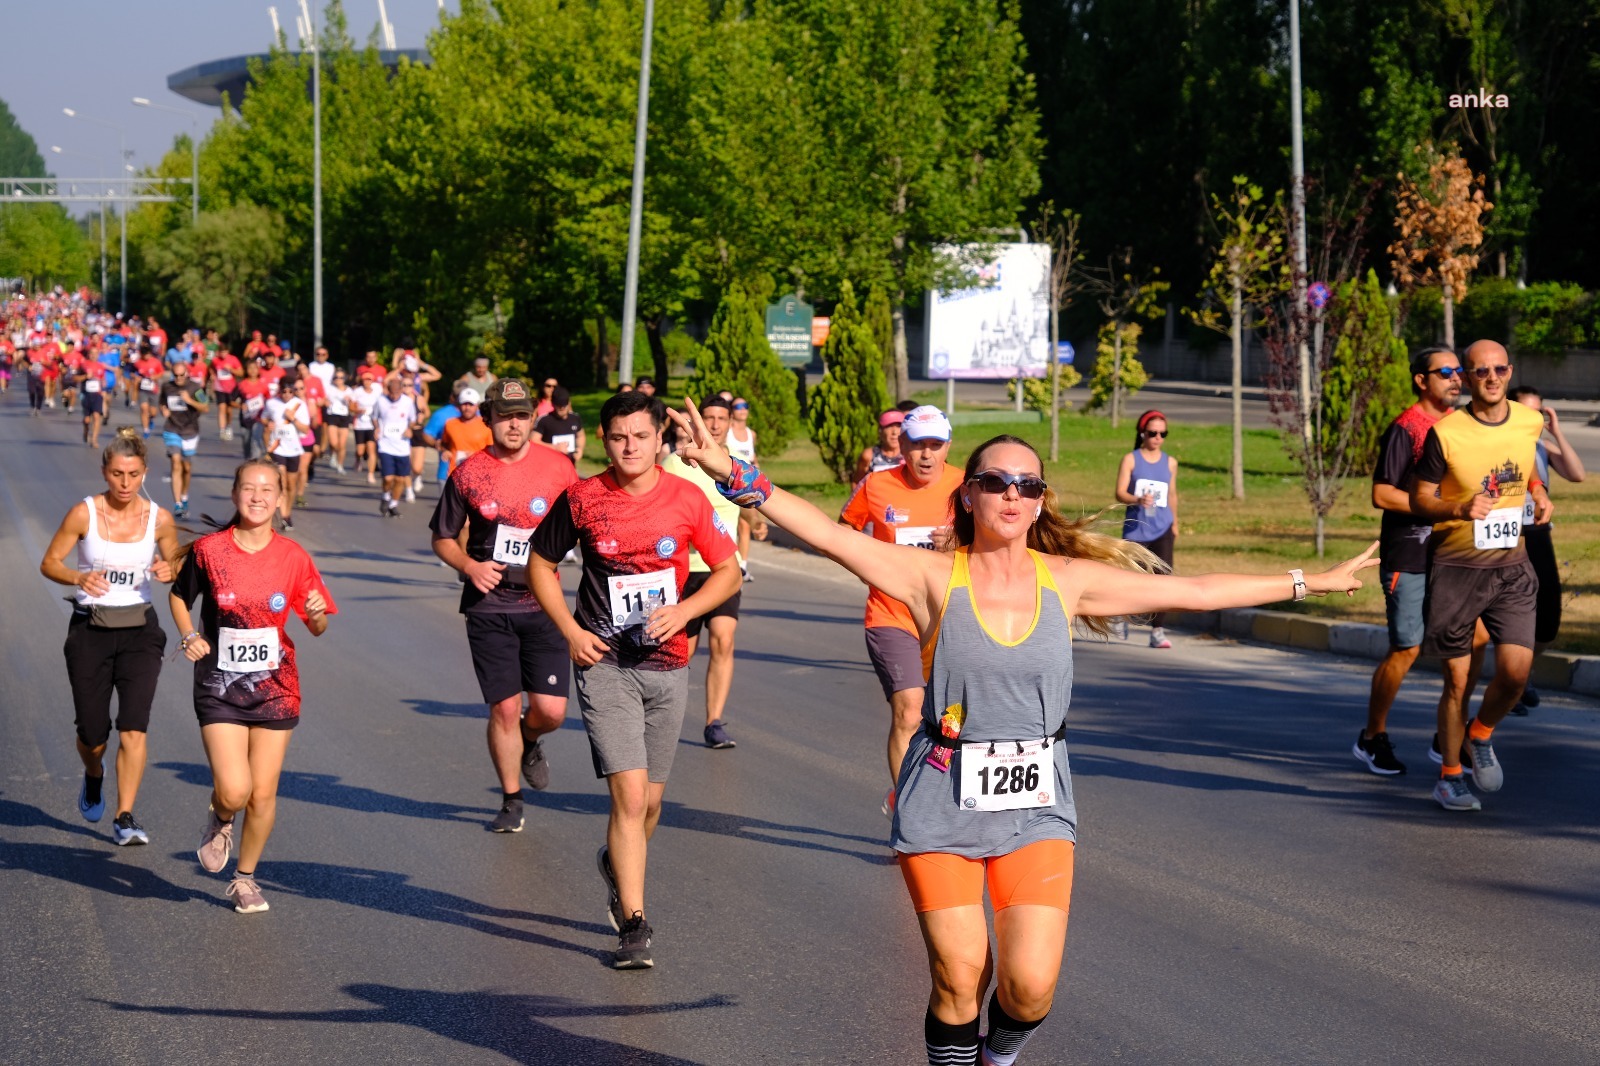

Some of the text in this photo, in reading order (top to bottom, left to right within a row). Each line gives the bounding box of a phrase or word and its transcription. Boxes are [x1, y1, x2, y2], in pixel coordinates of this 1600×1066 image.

[1484, 521, 1518, 539] 1348
[622, 587, 666, 613] 114
[228, 644, 268, 662] 1236
[978, 763, 1039, 795] 1286
